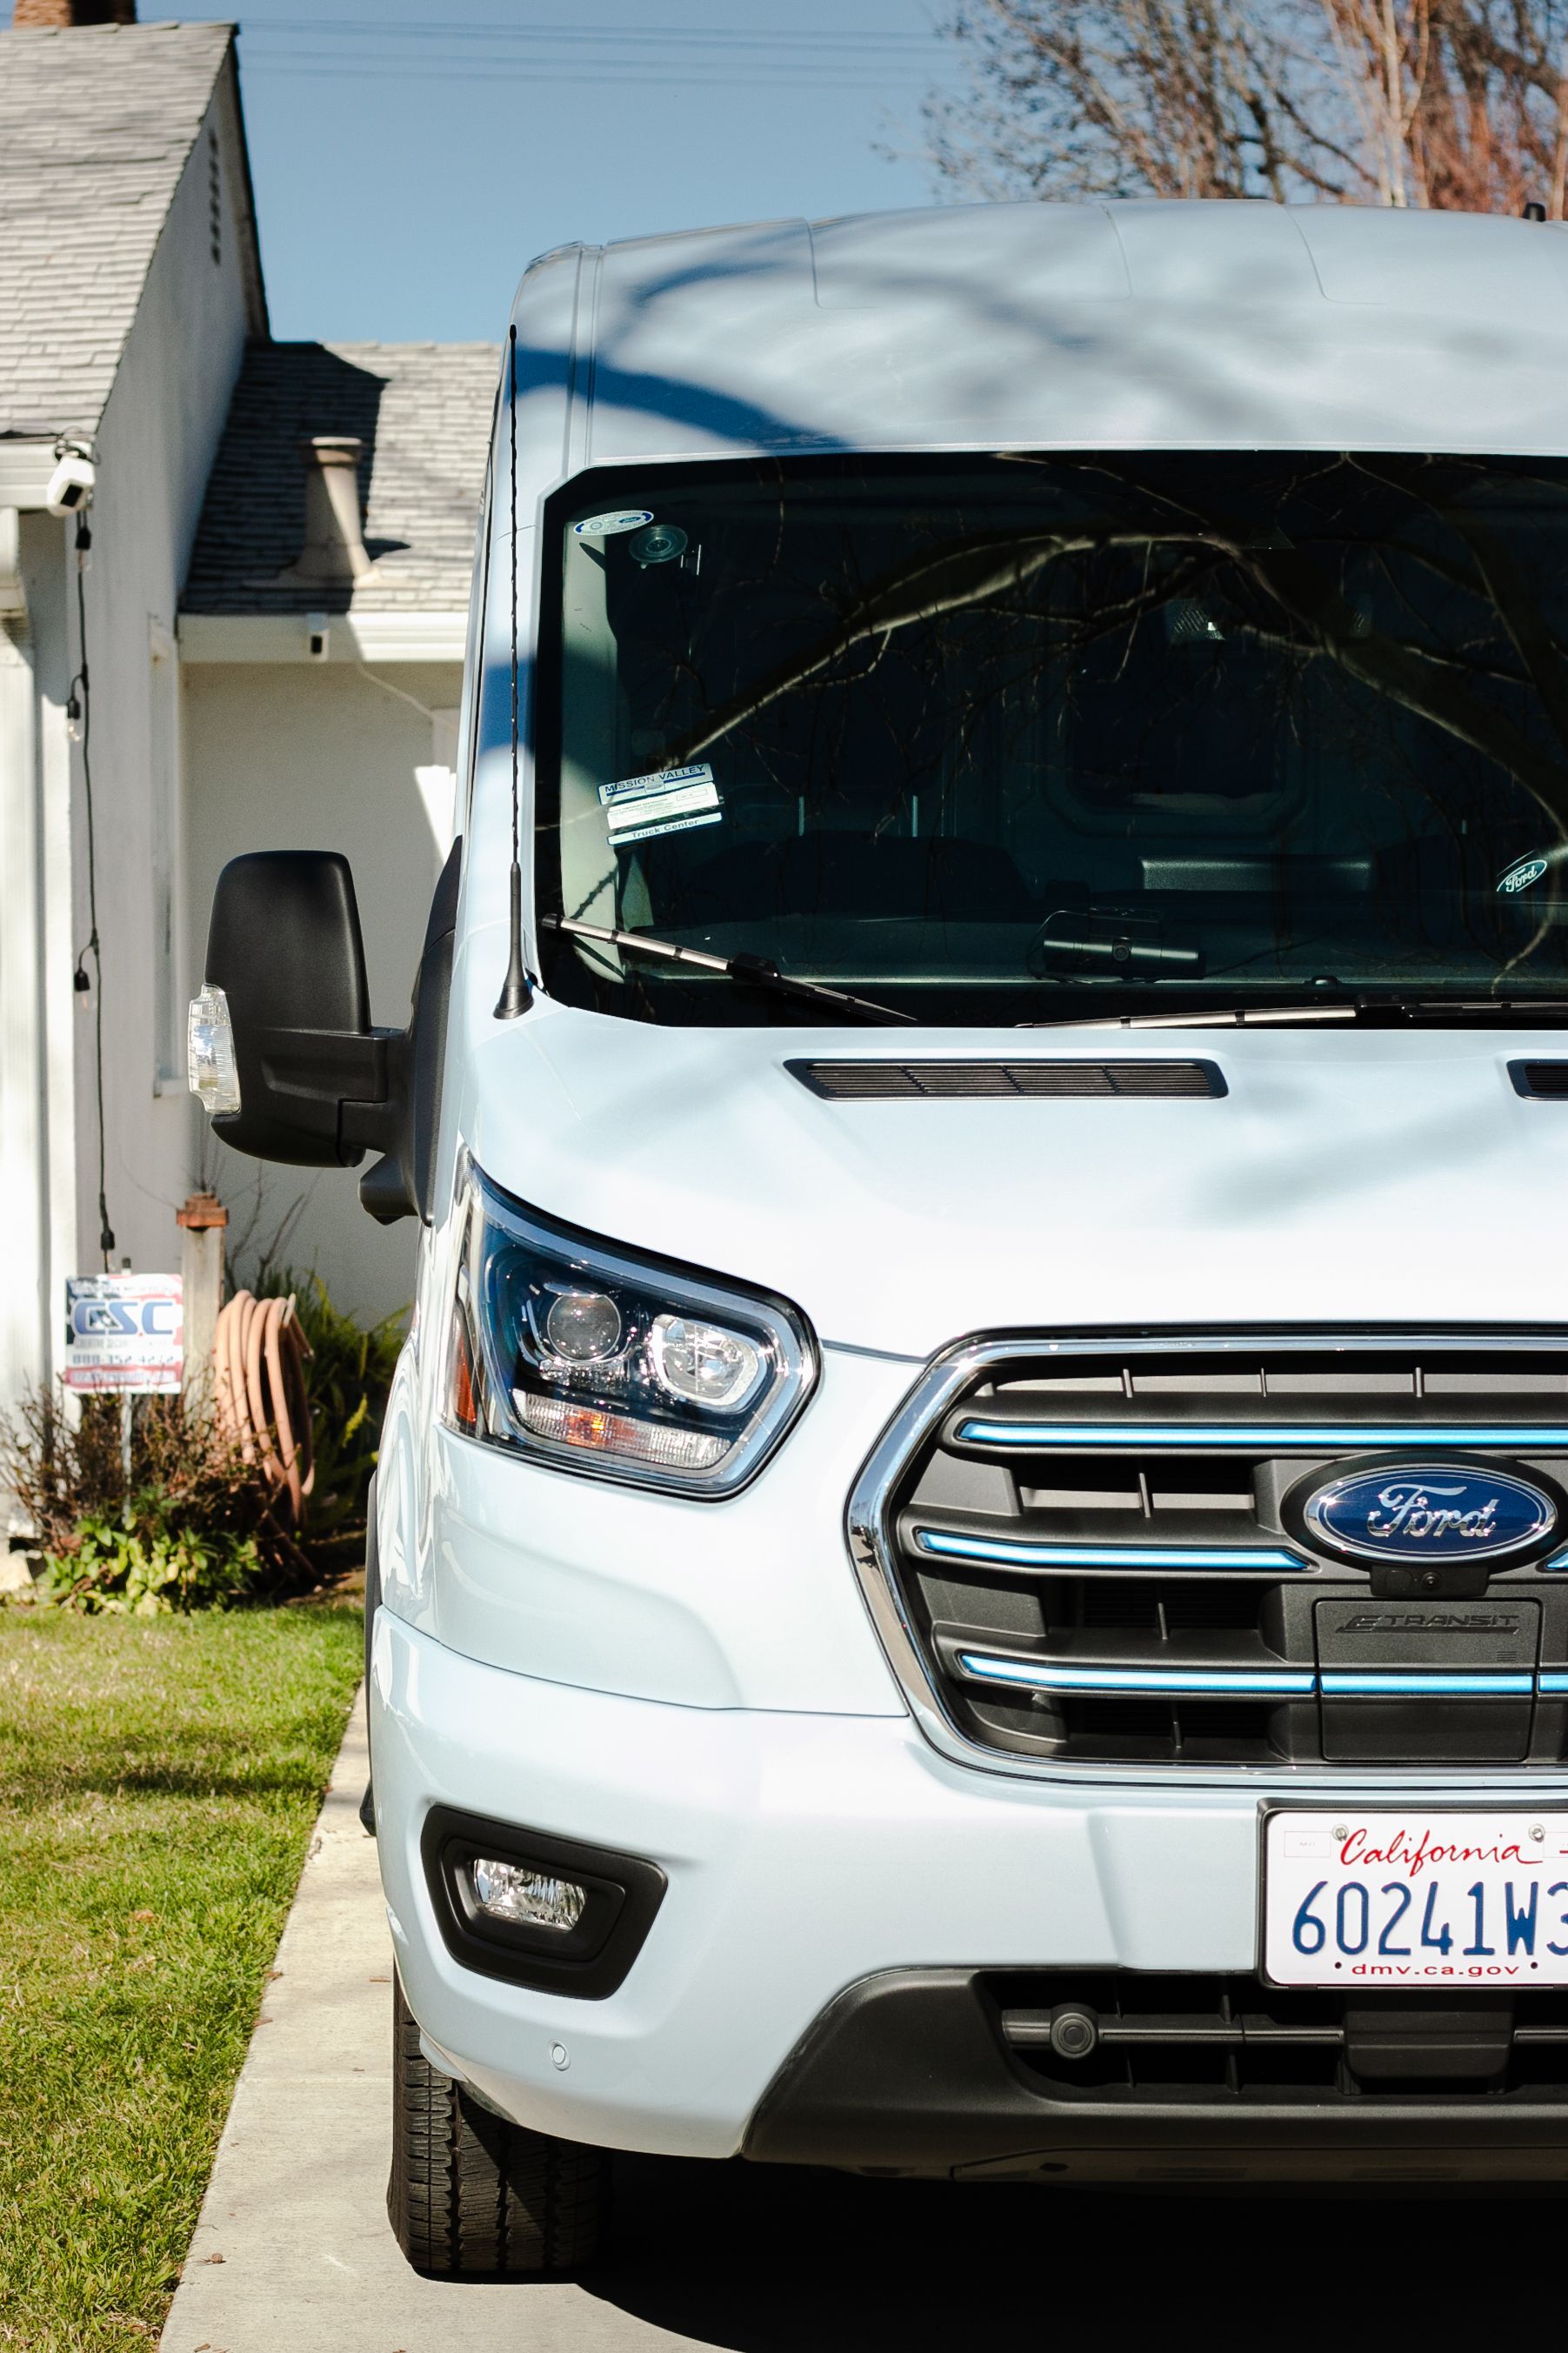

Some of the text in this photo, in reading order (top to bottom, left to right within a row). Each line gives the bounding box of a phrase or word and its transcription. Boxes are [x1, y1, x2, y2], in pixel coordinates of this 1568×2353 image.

[604, 776, 655, 792] MISSION
[658, 765, 704, 780] VALLEY
[631, 819, 699, 839] Truck Center
[1505, 866, 1537, 892] Ford
[1366, 1483, 1500, 1537] Ford
[1340, 1828, 1544, 1877] California
[1351, 1963, 1520, 1977] dmv.ca.gov
